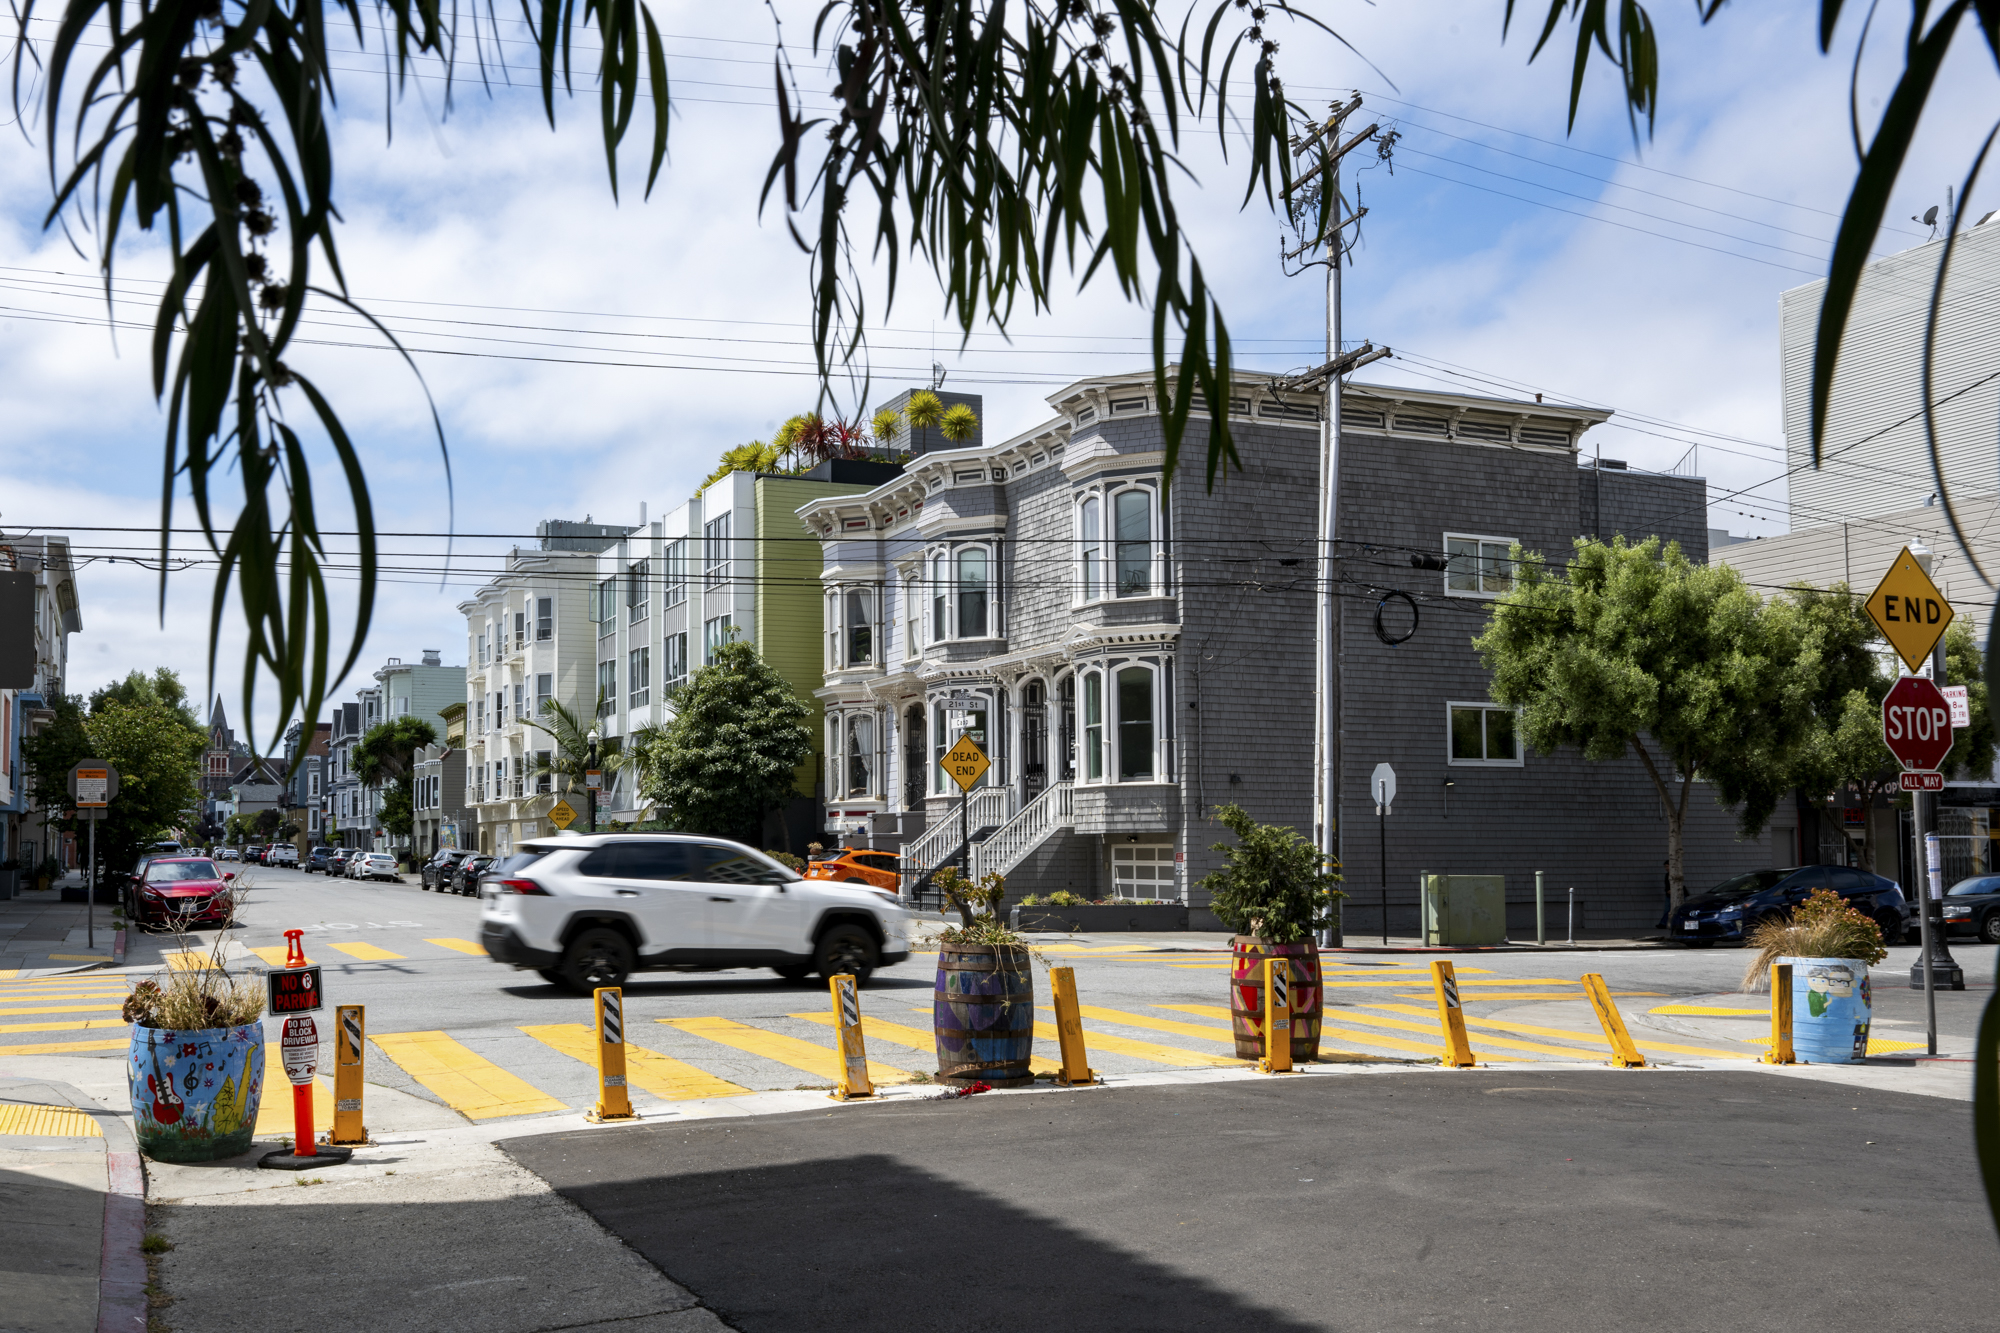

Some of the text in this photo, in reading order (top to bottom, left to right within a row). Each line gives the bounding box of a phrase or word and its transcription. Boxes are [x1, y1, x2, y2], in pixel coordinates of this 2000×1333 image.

[1885, 595, 1940, 624] END
[1943, 690, 1965, 698] PARKING
[1888, 706, 1947, 740] STOP
[953, 752, 979, 762] DEAD
[956, 766, 975, 775] END
[1904, 776, 1940, 787] ALL WAY
[281, 975, 298, 991] NO
[276, 991, 318, 1010] PARKING
[288, 1018, 312, 1029] DO NOT
[289, 1027, 312, 1037] BLOCK
[284, 1034, 317, 1045] DRIVEWAY
